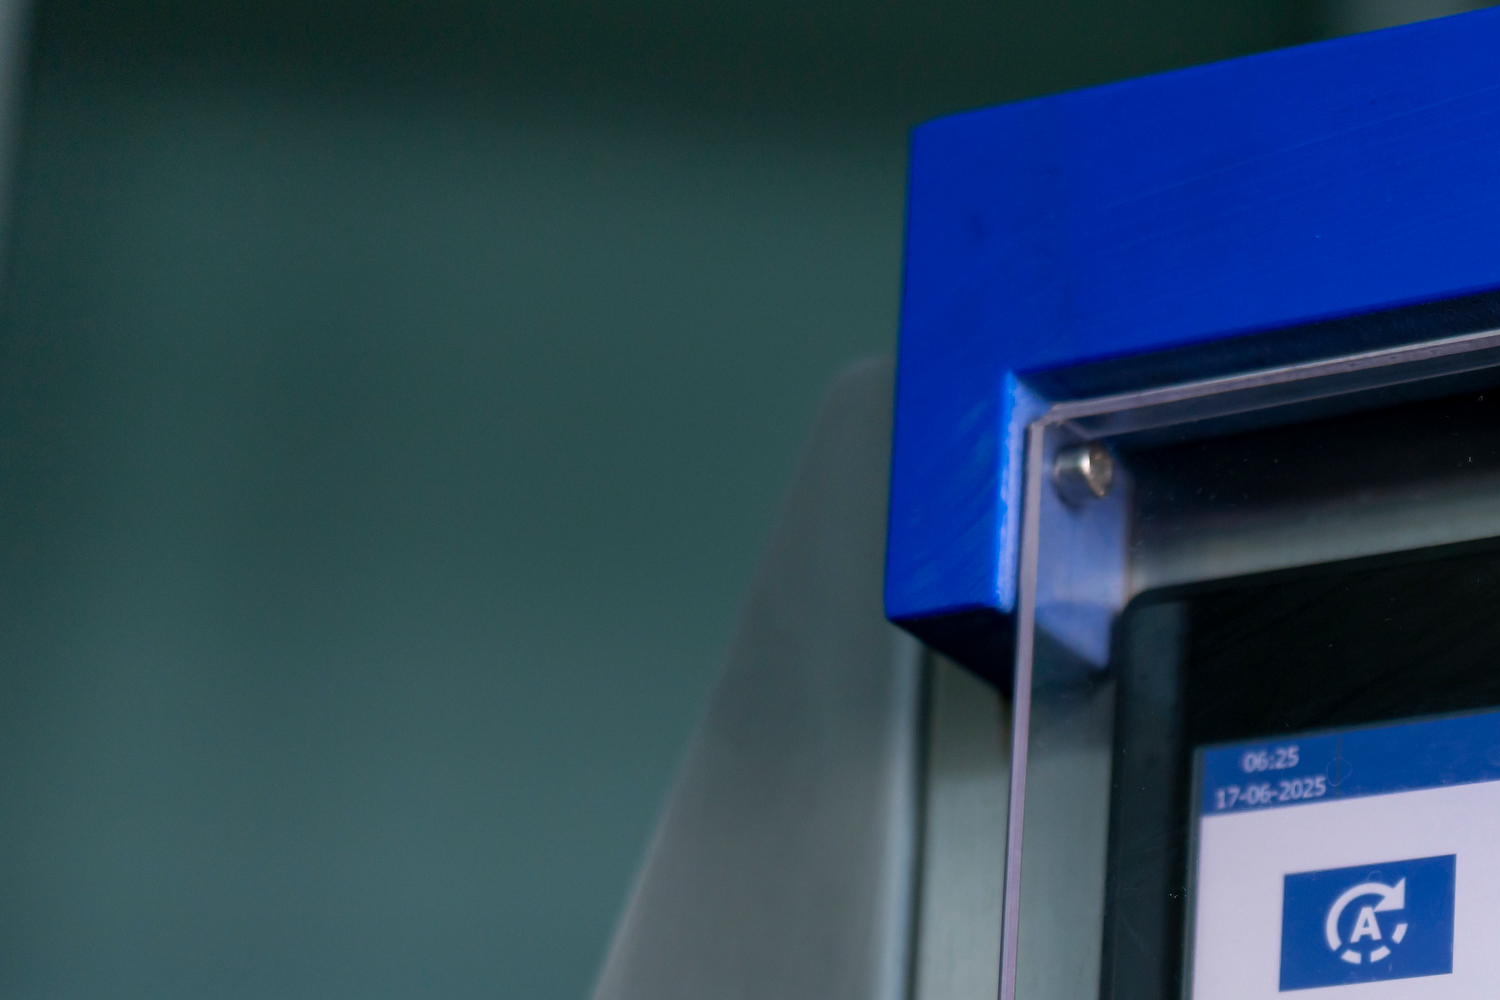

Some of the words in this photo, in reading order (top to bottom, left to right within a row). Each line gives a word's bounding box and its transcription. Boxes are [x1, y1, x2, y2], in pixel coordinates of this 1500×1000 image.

[1242, 746, 1300, 774] 06:25
[1215, 776, 1327, 810] 17-06-2025
[1350, 906, 1382, 943] A
